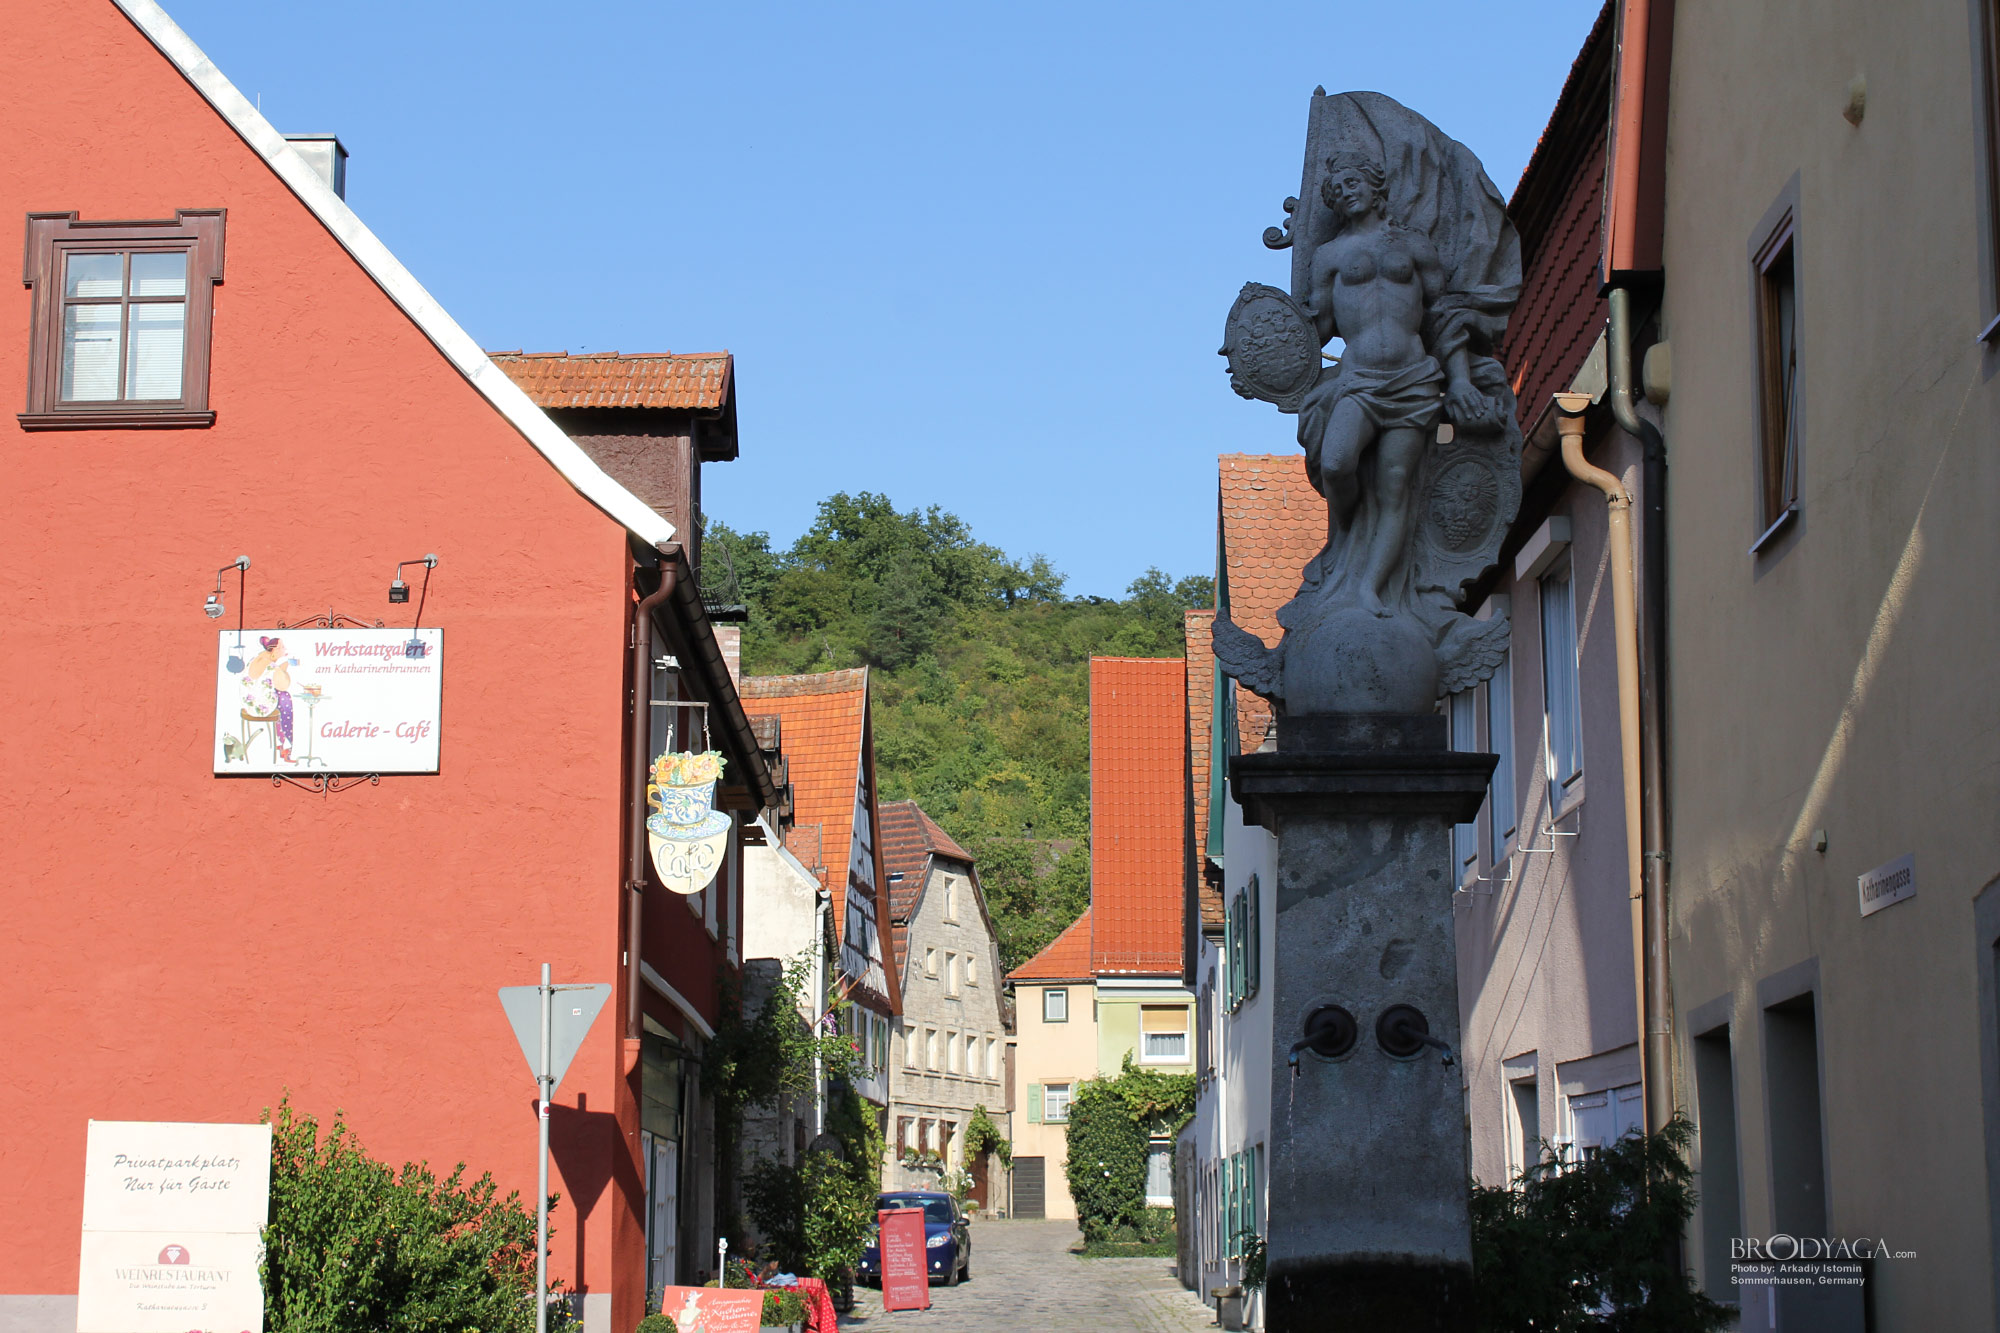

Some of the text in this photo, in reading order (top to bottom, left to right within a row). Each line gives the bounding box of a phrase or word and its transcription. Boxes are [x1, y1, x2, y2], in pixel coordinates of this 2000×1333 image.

[315, 641, 433, 661] Werkstattgalerie
[315, 663, 431, 674] am Katharinenbrunnen
[320, 720, 379, 739] Galerie
[395, 720, 431, 743] Café
[114, 1154, 240, 1171] Privatparkplatz
[123, 1176, 231, 1195] Nur für Gäste
[115, 1268, 232, 1282] WEINRESTAURANT
